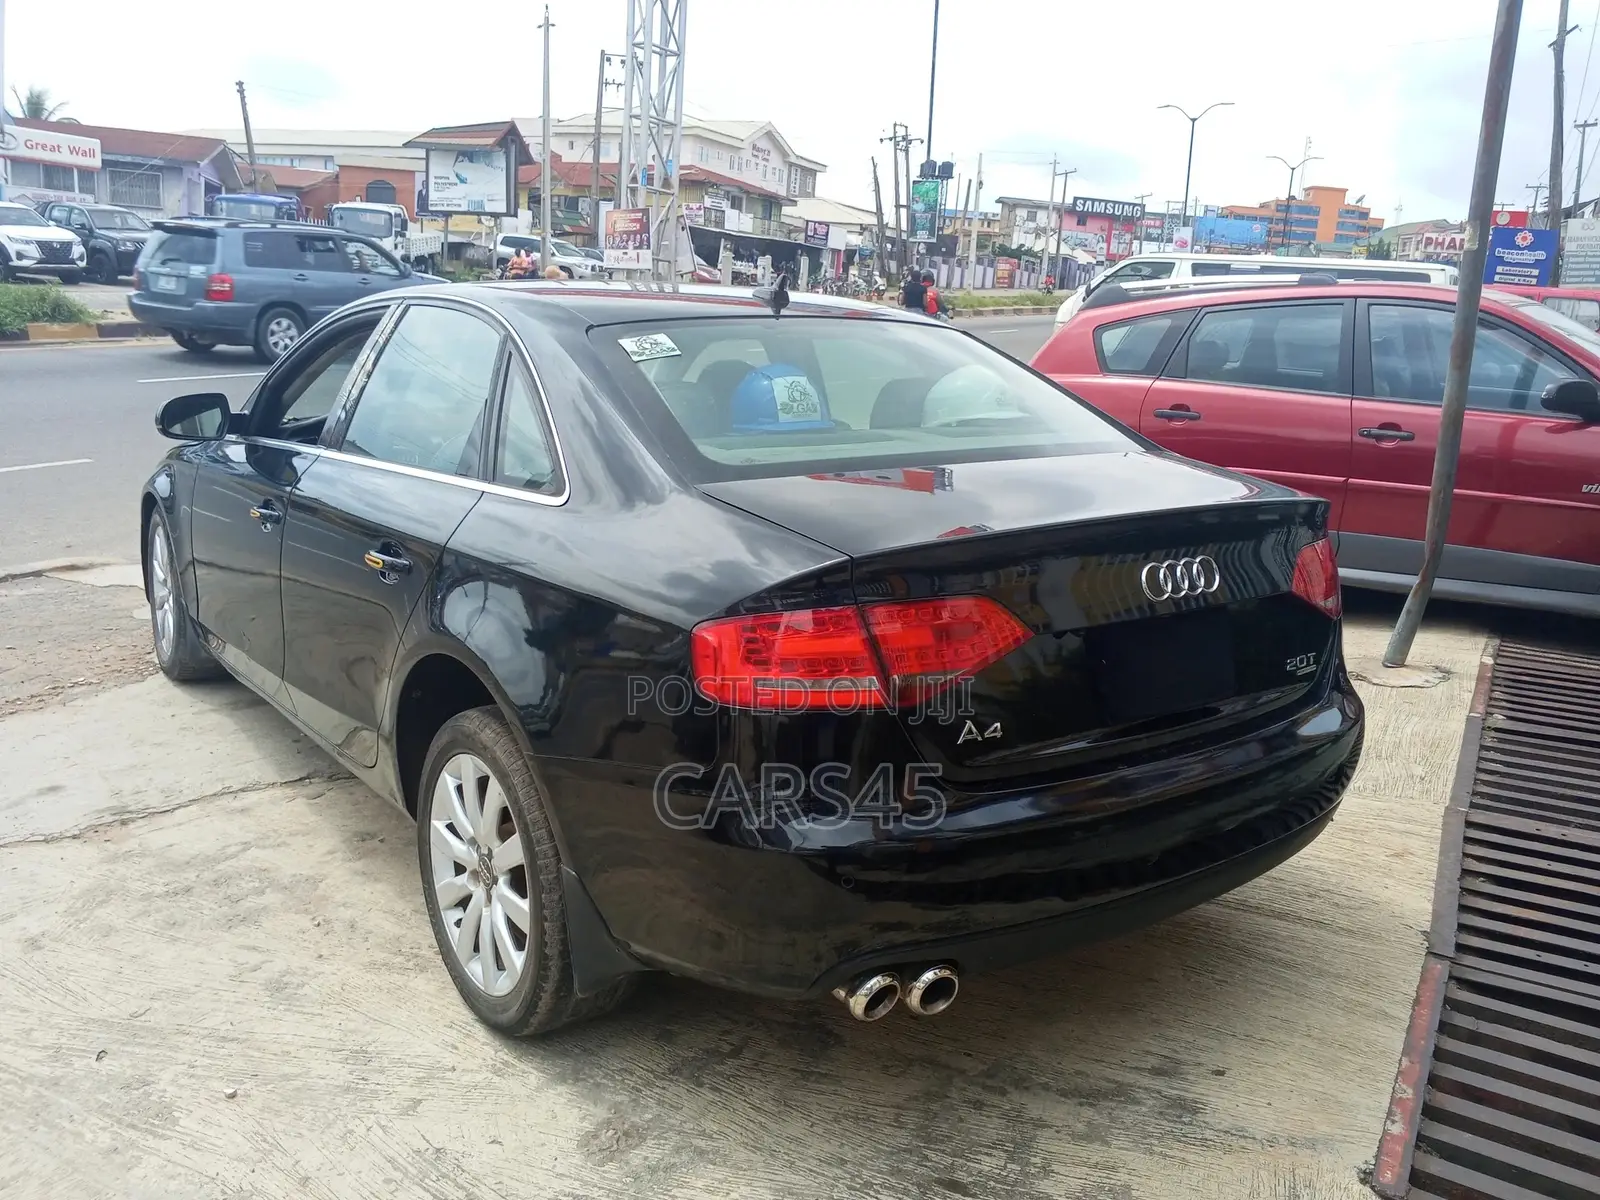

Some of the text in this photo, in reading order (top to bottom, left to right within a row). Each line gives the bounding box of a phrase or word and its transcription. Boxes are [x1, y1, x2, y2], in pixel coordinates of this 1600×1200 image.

[24, 139, 96, 159] Great Wall
[1075, 199, 1142, 218] SAMSUNG
[1496, 249, 1546, 259] beaconhealth
[1501, 267, 1534, 275] Laboratory
[957, 720, 1003, 745] A4
